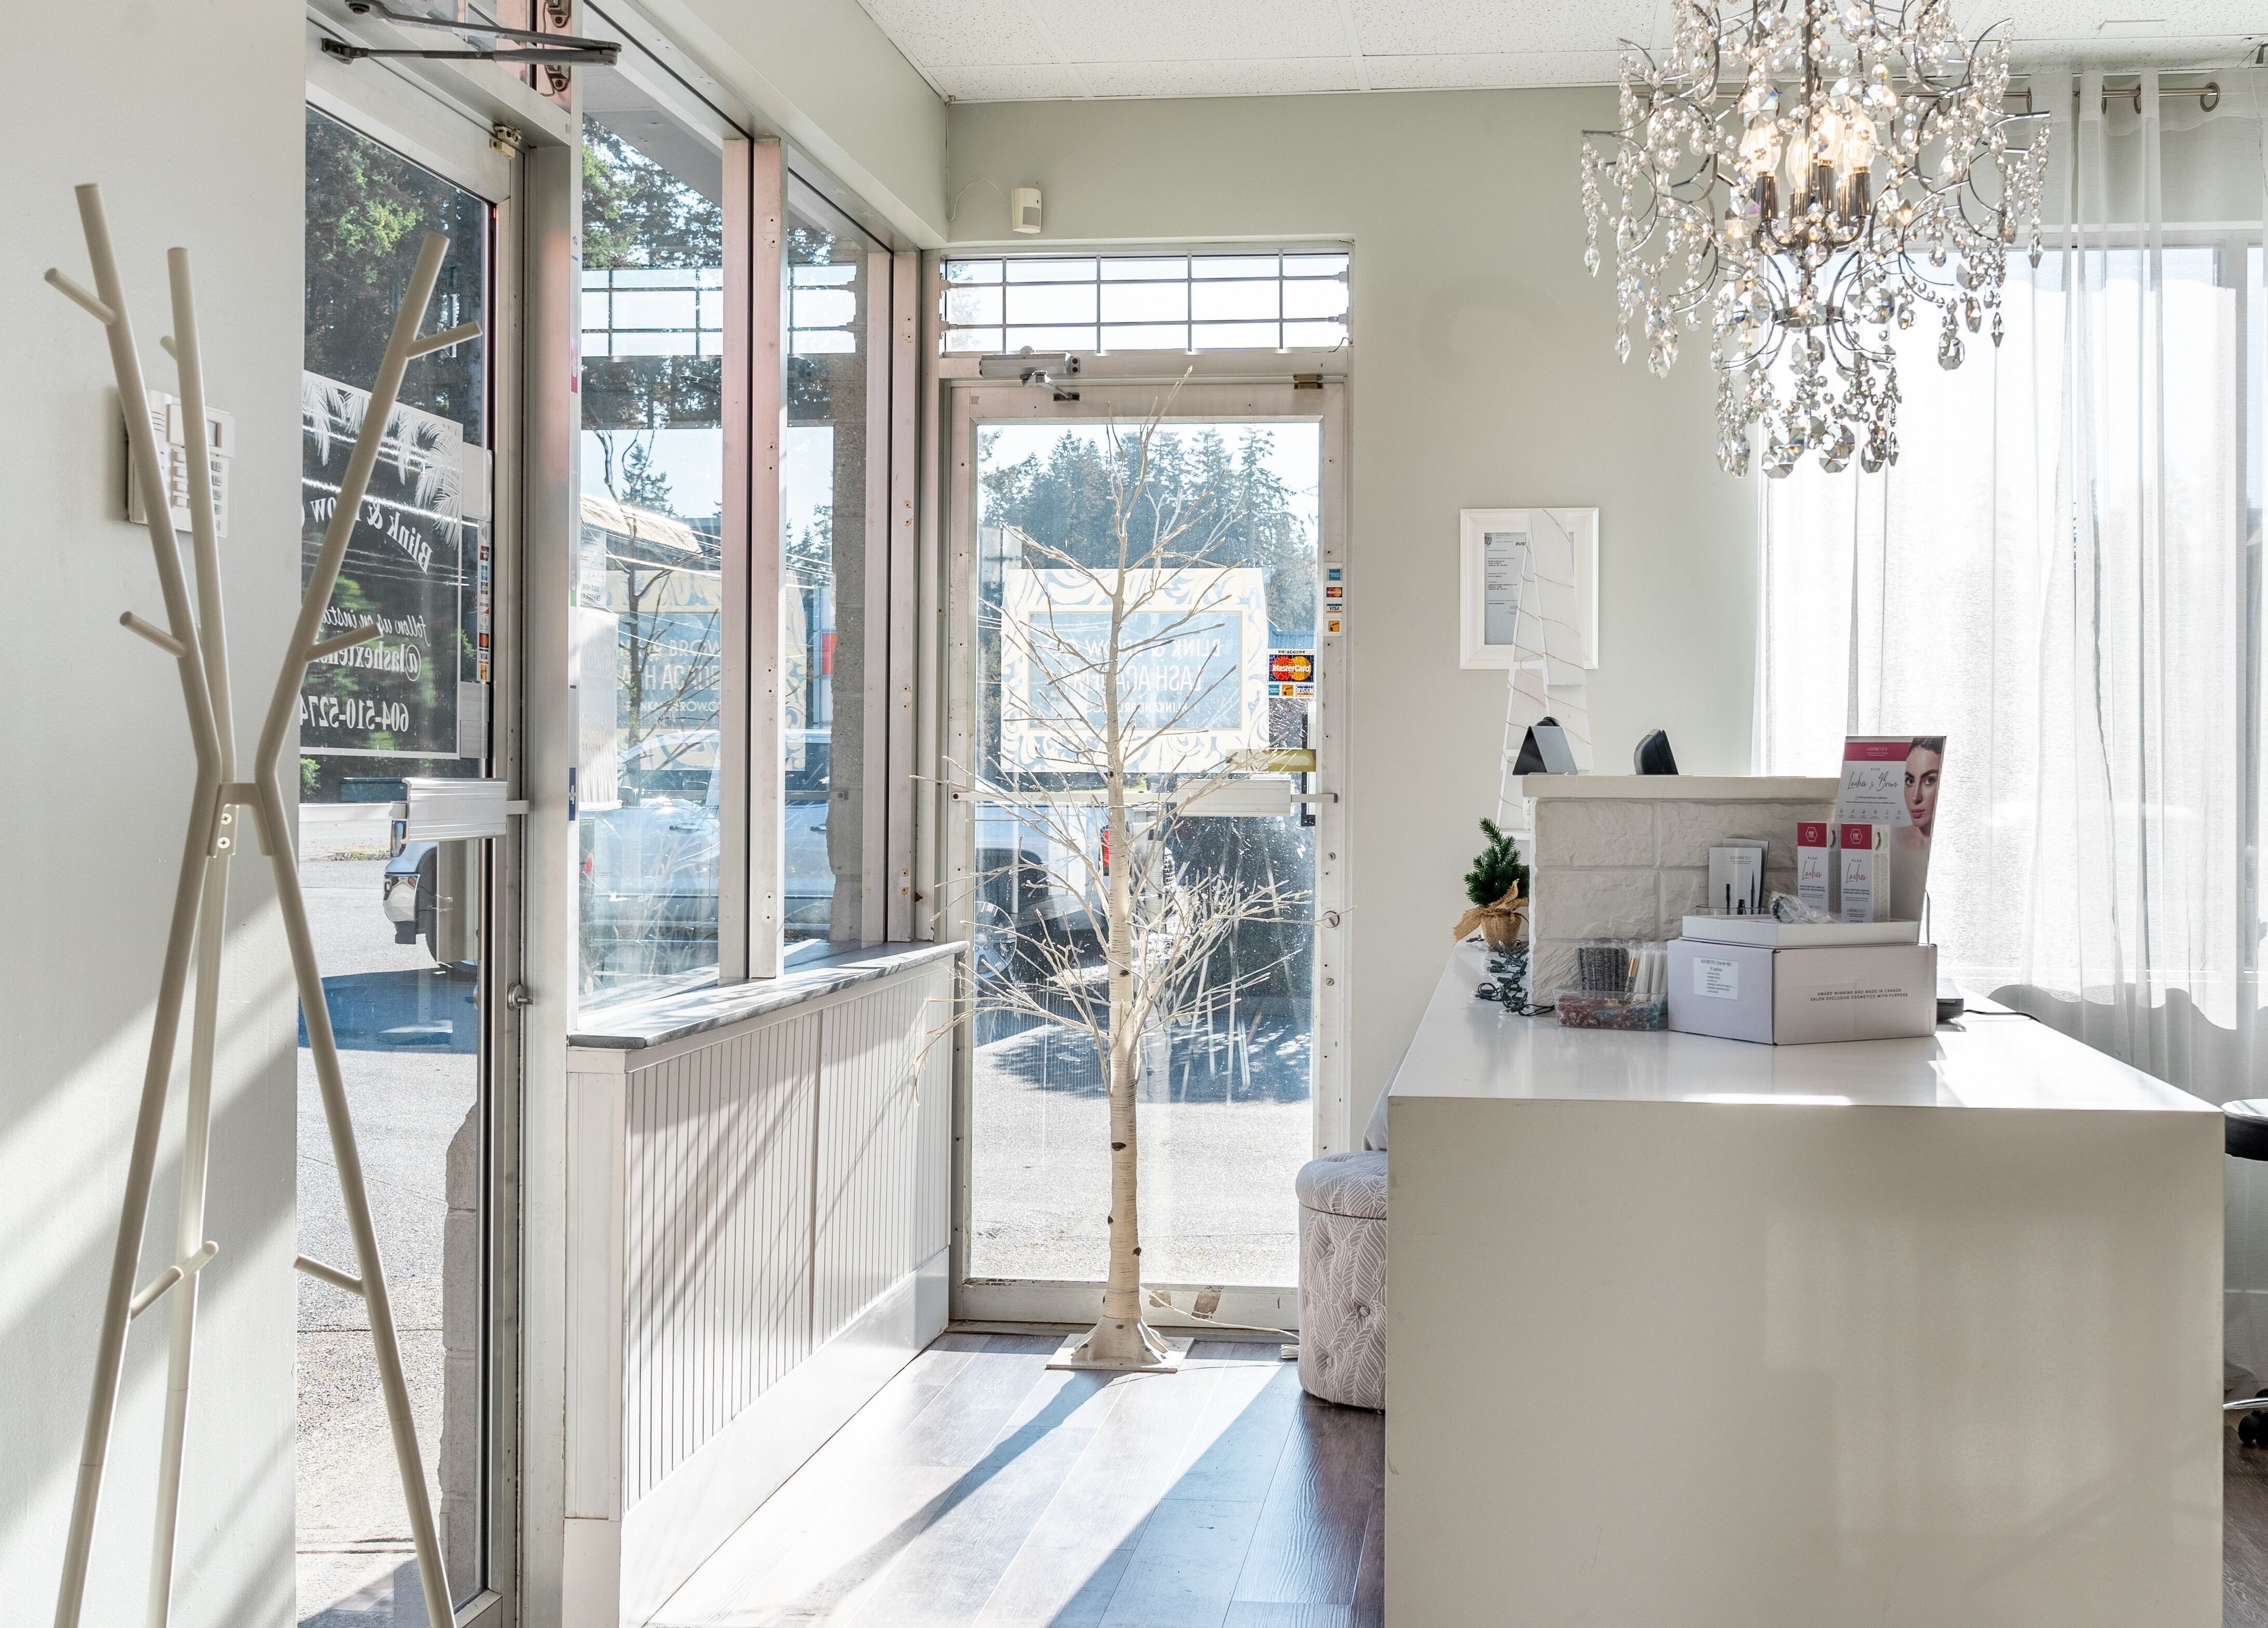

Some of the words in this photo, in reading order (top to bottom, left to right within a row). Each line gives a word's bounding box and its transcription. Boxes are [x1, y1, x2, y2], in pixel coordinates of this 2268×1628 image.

[1272, 664, 1311, 672] MasterCard
[1847, 771, 1868, 790] Lashes
[1801, 860, 1822, 881] Lashes
[1845, 863, 1867, 884] Lashes
